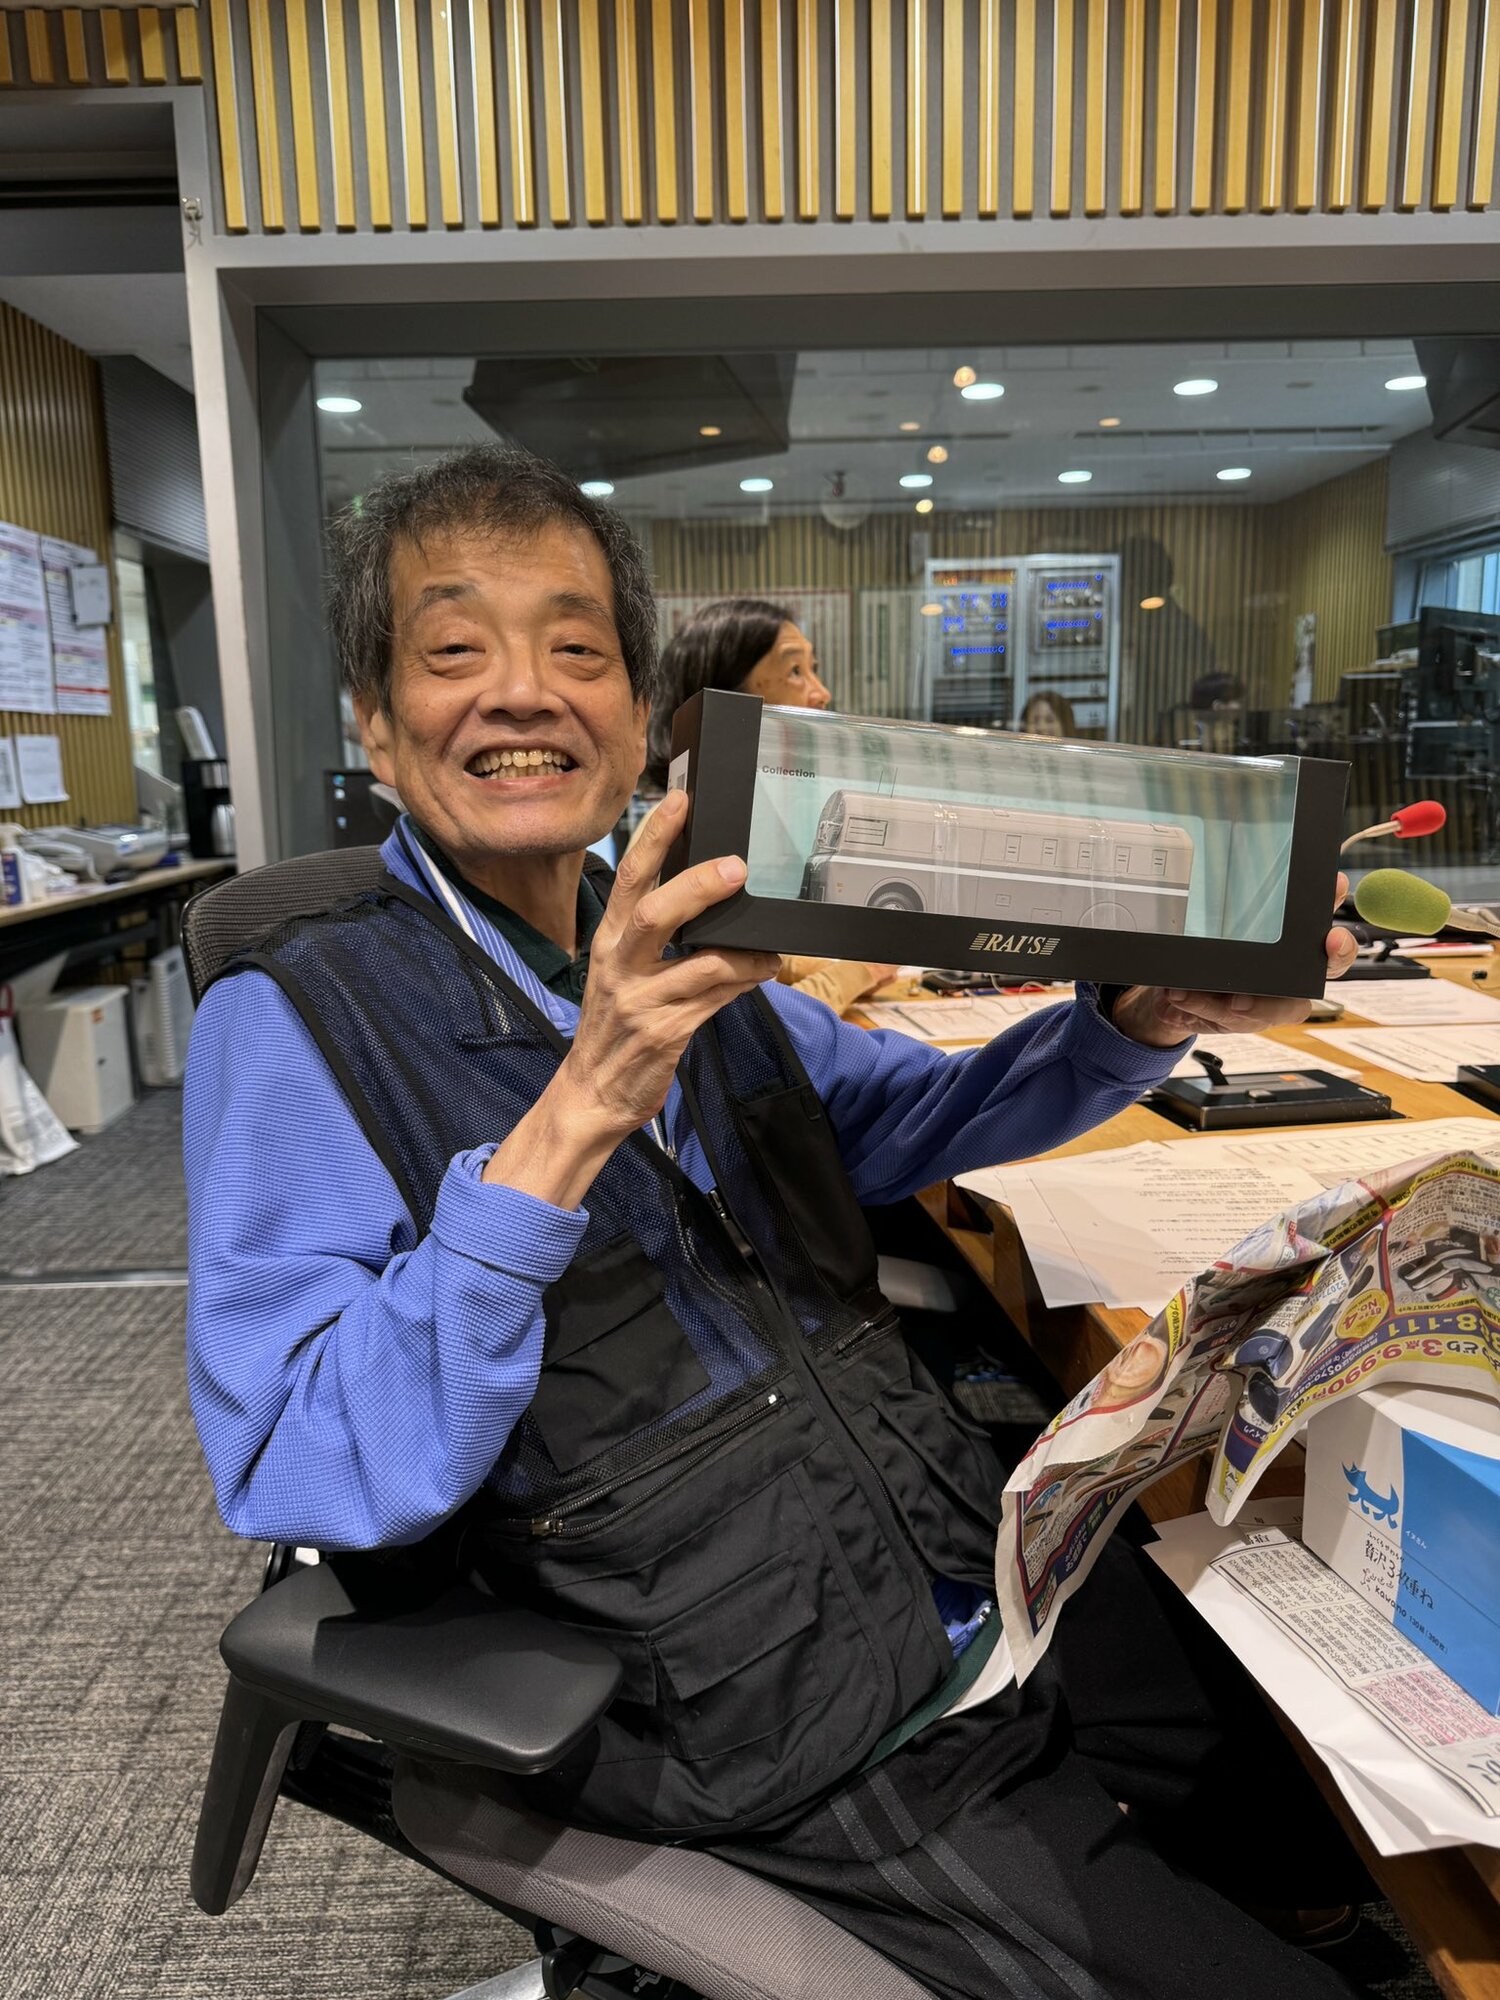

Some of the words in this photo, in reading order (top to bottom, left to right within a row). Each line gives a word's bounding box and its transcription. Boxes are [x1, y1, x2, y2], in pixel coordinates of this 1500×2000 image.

[761, 765, 816, 779] Collection
[983, 933, 1046, 954] RAI'S
[1364, 1539, 1435, 1610] 贅沢3枚重ね
